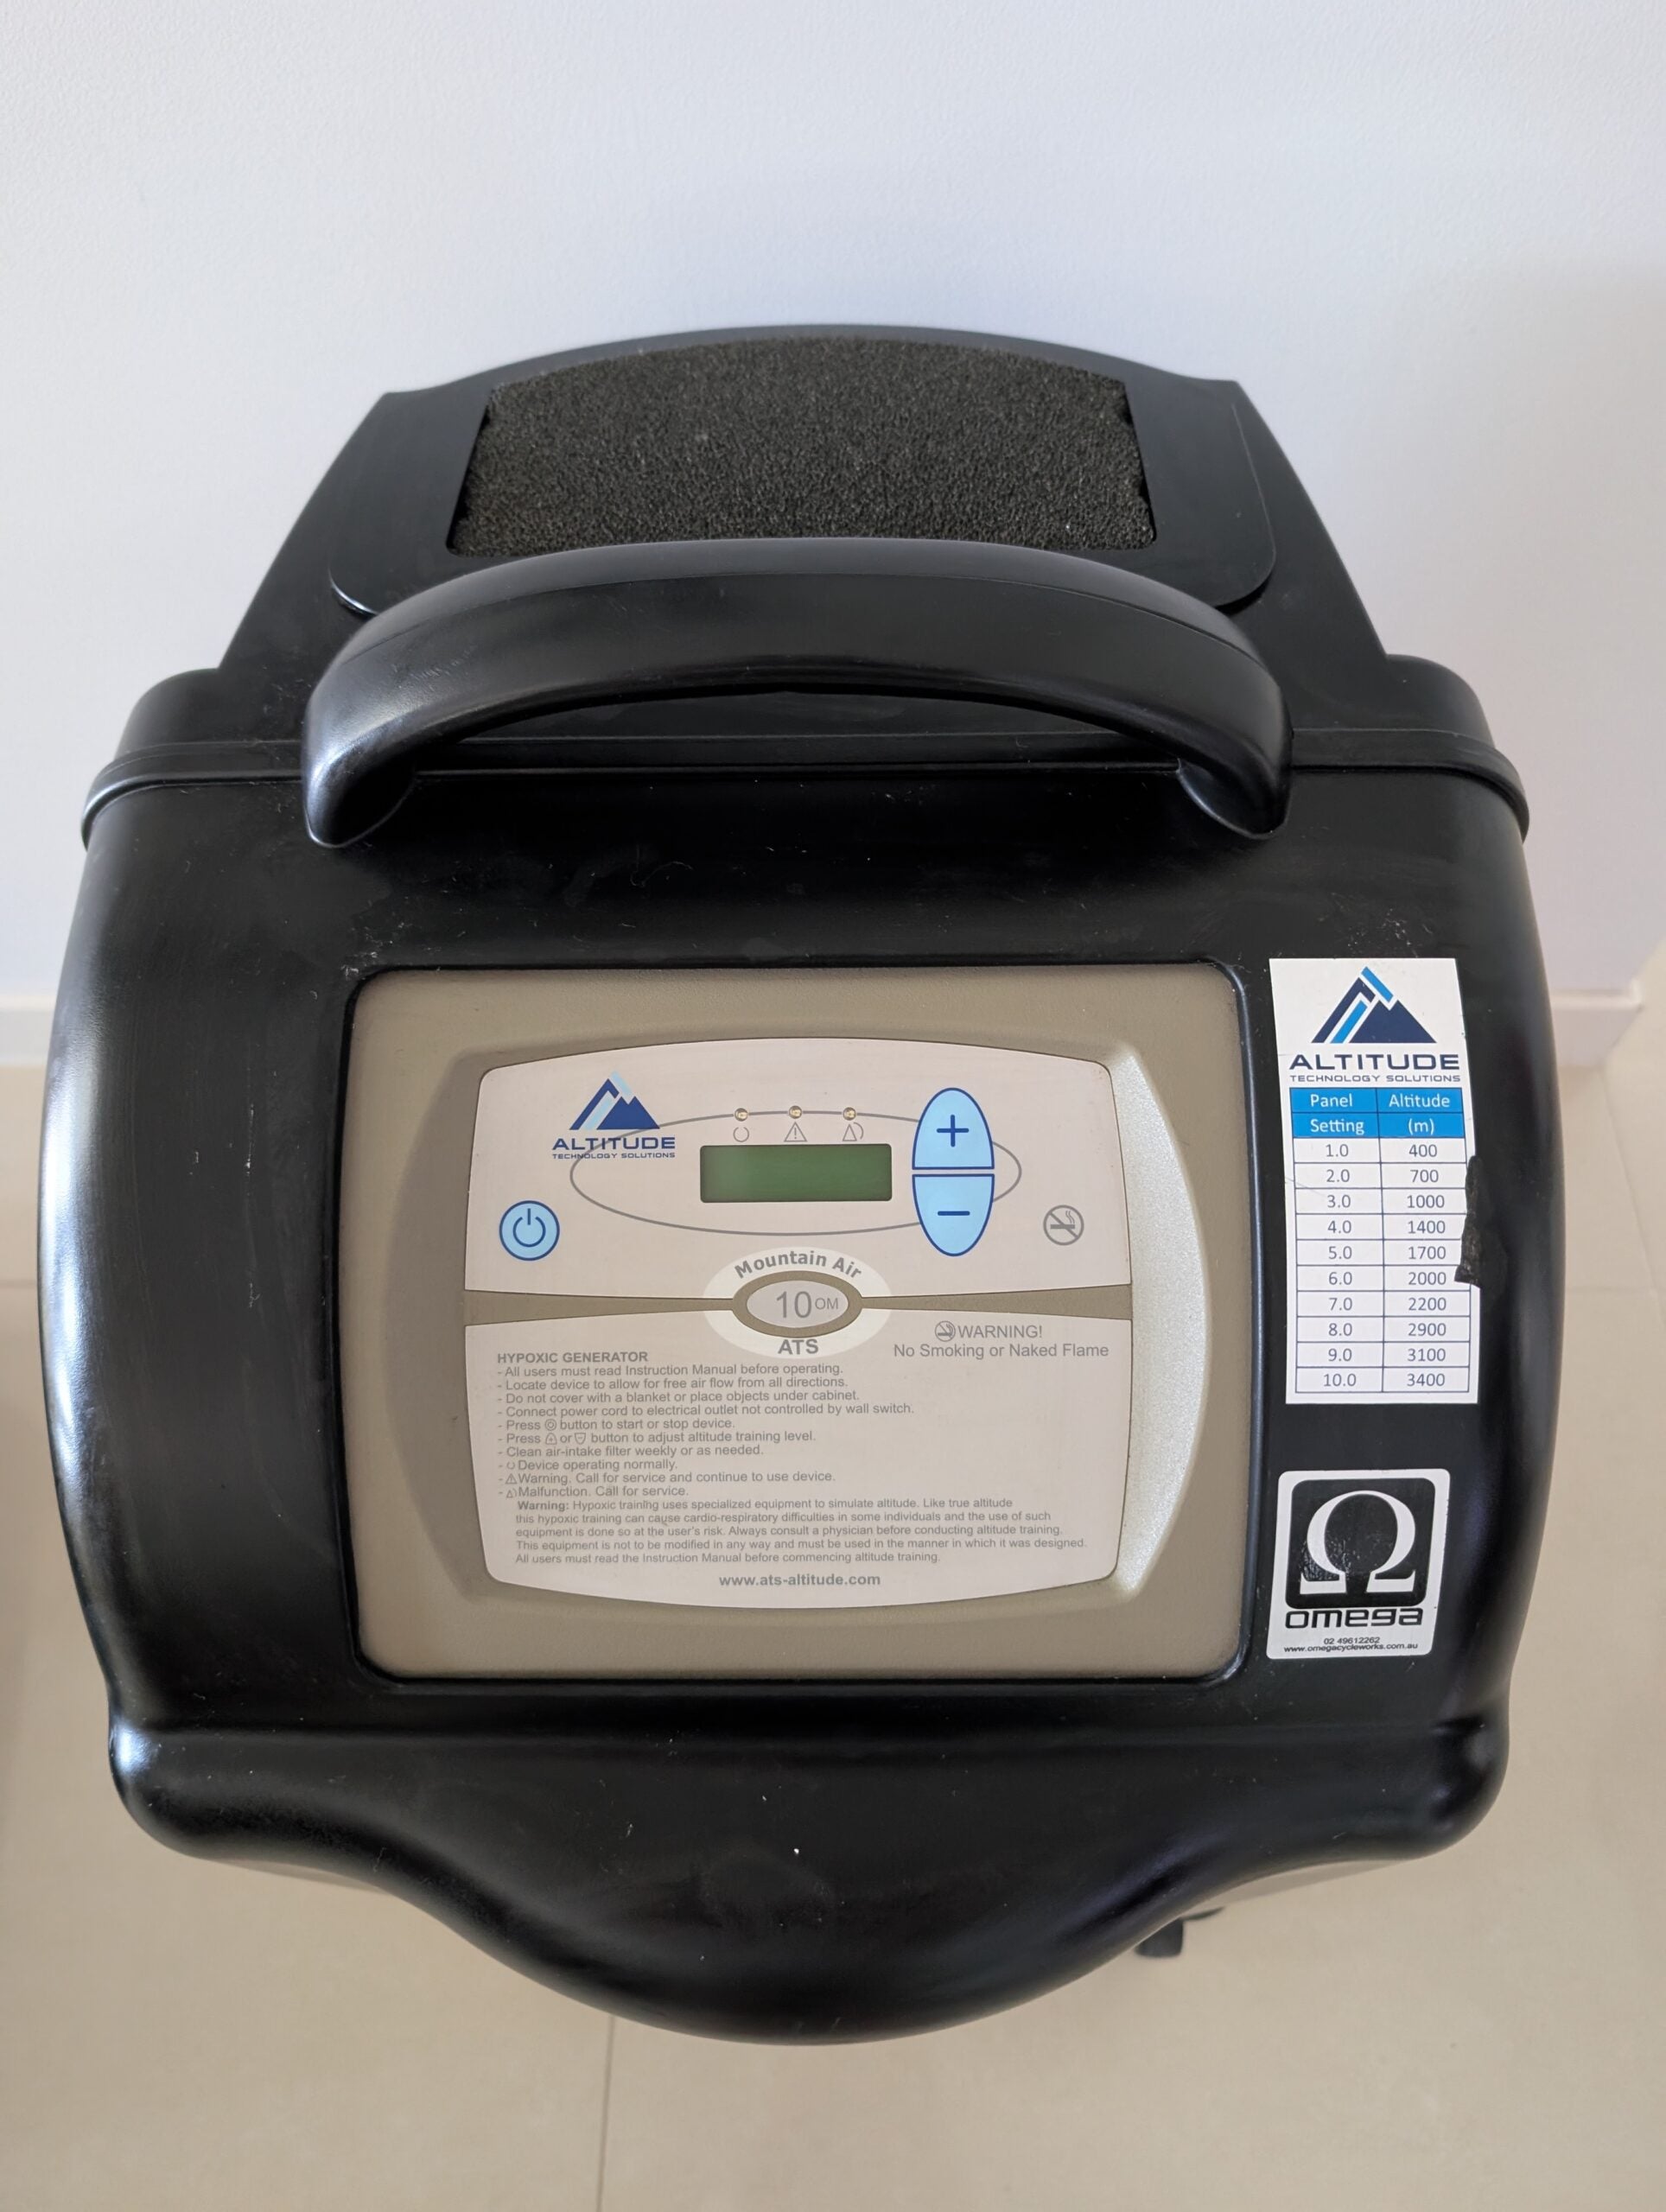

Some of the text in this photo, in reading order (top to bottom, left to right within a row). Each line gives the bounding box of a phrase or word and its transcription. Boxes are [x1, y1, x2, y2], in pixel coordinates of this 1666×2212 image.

[1289, 1054, 1460, 1071] ALTITUDE
[1311, 1094, 1353, 1107] Panel
[1389, 1093, 1450, 1108] Altitude
[1311, 1119, 1364, 1135] Setting
[1408, 1119, 1435, 1135] (m)
[552, 1137, 676, 1150] ALTITUDE
[1326, 1144, 1349, 1157] 1.0
[1408, 1144, 1438, 1157] 400
[1326, 1169, 1350, 1183] 2.0
[1410, 1169, 1439, 1183] 700
[1326, 1194, 1351, 1208] 3.0
[1407, 1194, 1445, 1208] 1000
[1327, 1220, 1351, 1234] 4.0
[1408, 1220, 1446, 1234] 1400
[1328, 1246, 1352, 1260] 5.0
[1408, 1246, 1447, 1260] 1700
[734, 1250, 862, 1280] Mountain Air
[1328, 1272, 1352, 1285] 6.0
[1408, 1272, 1447, 1285] 2000
[1329, 1297, 1352, 1311] 7.0
[1408, 1297, 1447, 1311] 2200
[957, 1325, 1043, 1339] WARNING!
[1328, 1323, 1352, 1336] 8.0
[1408, 1323, 1447, 1336] 2900
[778, 1338, 819, 1356] ATS
[893, 1343, 1109, 1358] No Smoking or Naked Flame
[497, 1351, 648, 1363] HYPOXIC GENERATOR
[1328, 1348, 1352, 1362] 9.0
[1408, 1348, 1446, 1362] 3100
[505, 1365, 519, 1376] All
[560, 1365, 591, 1376] must
[595, 1365, 621, 1376] read
[625, 1364, 688, 1375] Instruction
[692, 1364, 736, 1375] Manual
[740, 1363, 779, 1374] before
[782, 1363, 843, 1376] operating.
[505, 1376, 848, 1389] Locate device to allow for free air flow from all directions.
[1323, 1373, 1357, 1387] 10.0
[1407, 1373, 1445, 1387] 3400
[506, 1392, 523, 1402] Do
[526, 1392, 546, 1402] not
[550, 1394, 583, 1402] cover
[586, 1392, 610, 1402] with
[625, 1391, 671, 1402] blanket
[690, 1391, 722, 1403] place
[726, 1391, 769, 1403] objects
[773, 1390, 809, 1401] under
[811, 1390, 859, 1401] cabinet.
[506, 1406, 556, 1416] Connect
[560, 1408, 598, 1418] power
[601, 1405, 627, 1415] cord
[632, 1405, 643, 1415] to
[646, 1405, 700, 1415] electrical
[704, 1405, 738, 1415] outlet
[741, 1404, 760, 1414] not
[764, 1404, 823, 1414] controlled
[827, 1404, 842, 1416] by
[845, 1403, 868, 1414] wall
[506, 1419, 541, 1429] Press
[560, 1419, 597, 1429] button
[601, 1419, 613, 1429] to
[616, 1419, 643, 1429] start
[663, 1418, 688, 1431] stop
[692, 1418, 734, 1428] device.
[506, 1433, 541, 1443] Press
[590, 1432, 628, 1442] button
[632, 1432, 644, 1442] to
[647, 1432, 684, 1444] adjust
[688, 1431, 732, 1441] altitude
[735, 1431, 780, 1443] training
[784, 1431, 816, 1440] level.
[506, 1446, 541, 1456] Clean
[545, 1446, 601, 1456] air-intake
[604, 1446, 631, 1456] filter
[634, 1446, 677, 1458] weekly
[715, 1445, 763, 1455] needed.
[518, 1459, 677, 1471] Device operating normally.
[518, 1471, 835, 1485] Warning. Call for service and continue to use device.
[518, 1486, 688, 1497] Malfunction. Call for service.
[517, 1499, 569, 1512] Warning:
[573, 1499, 616, 1511] Hypoxic
[690, 1498, 751, 1511] specialized
[754, 1498, 811, 1510] equipment
[814, 1498, 824, 1509] to
[828, 1498, 874, 1509] simulate
[876, 1497, 919, 1508] altitude.
[923, 1497, 945, 1508] Like
[948, 1497, 970, 1508] true
[973, 1497, 1013, 1508] altitude
[515, 1553, 528, 1563] All
[565, 1553, 591, 1563] must
[595, 1553, 619, 1563] read
[622, 1553, 639, 1563] the
[643, 1553, 697, 1563] Instruction
[702, 1552, 741, 1562] Manual
[745, 1552, 779, 1562] before
[782, 1552, 851, 1564] commencing
[855, 1552, 893, 1562] altitude
[897, 1552, 940, 1564] training.
[719, 1574, 881, 1586] www.ats-altitude.com
[1285, 1607, 1423, 1629] omega
[1284, 1643, 1418, 1653] www.omegacycleworks.com.au
